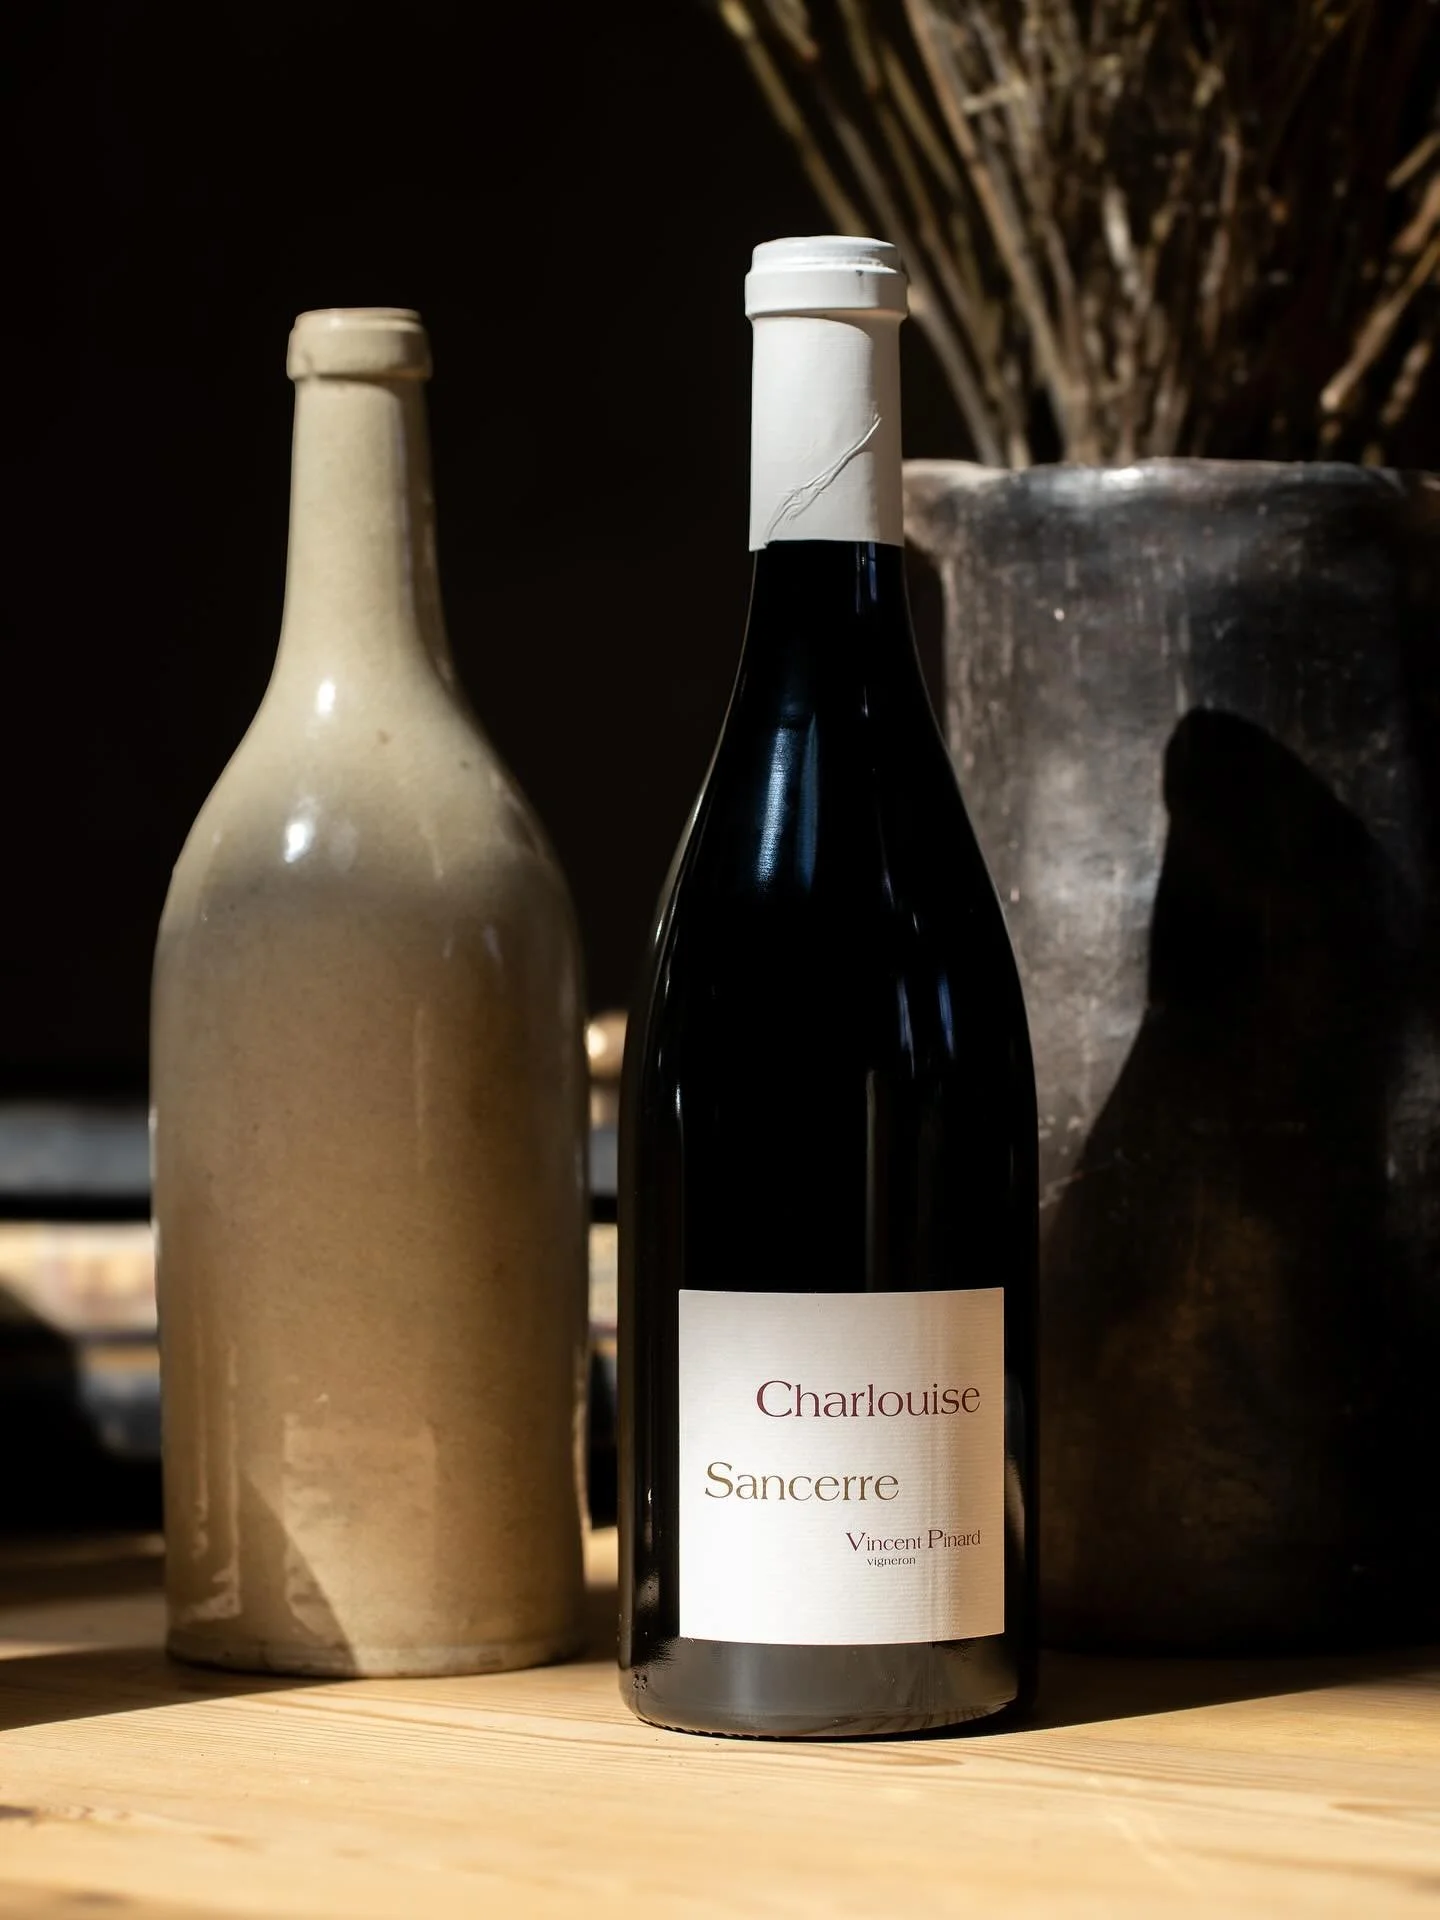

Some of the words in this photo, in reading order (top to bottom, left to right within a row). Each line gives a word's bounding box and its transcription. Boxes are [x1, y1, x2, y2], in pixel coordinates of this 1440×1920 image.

[756, 1380, 981, 1418] Charlouise
[704, 1461, 900, 1502] Sancerre
[846, 1531, 922, 1552] Vincent
[927, 1529, 981, 1550] Pinard
[867, 1556, 916, 1568] vigneron
